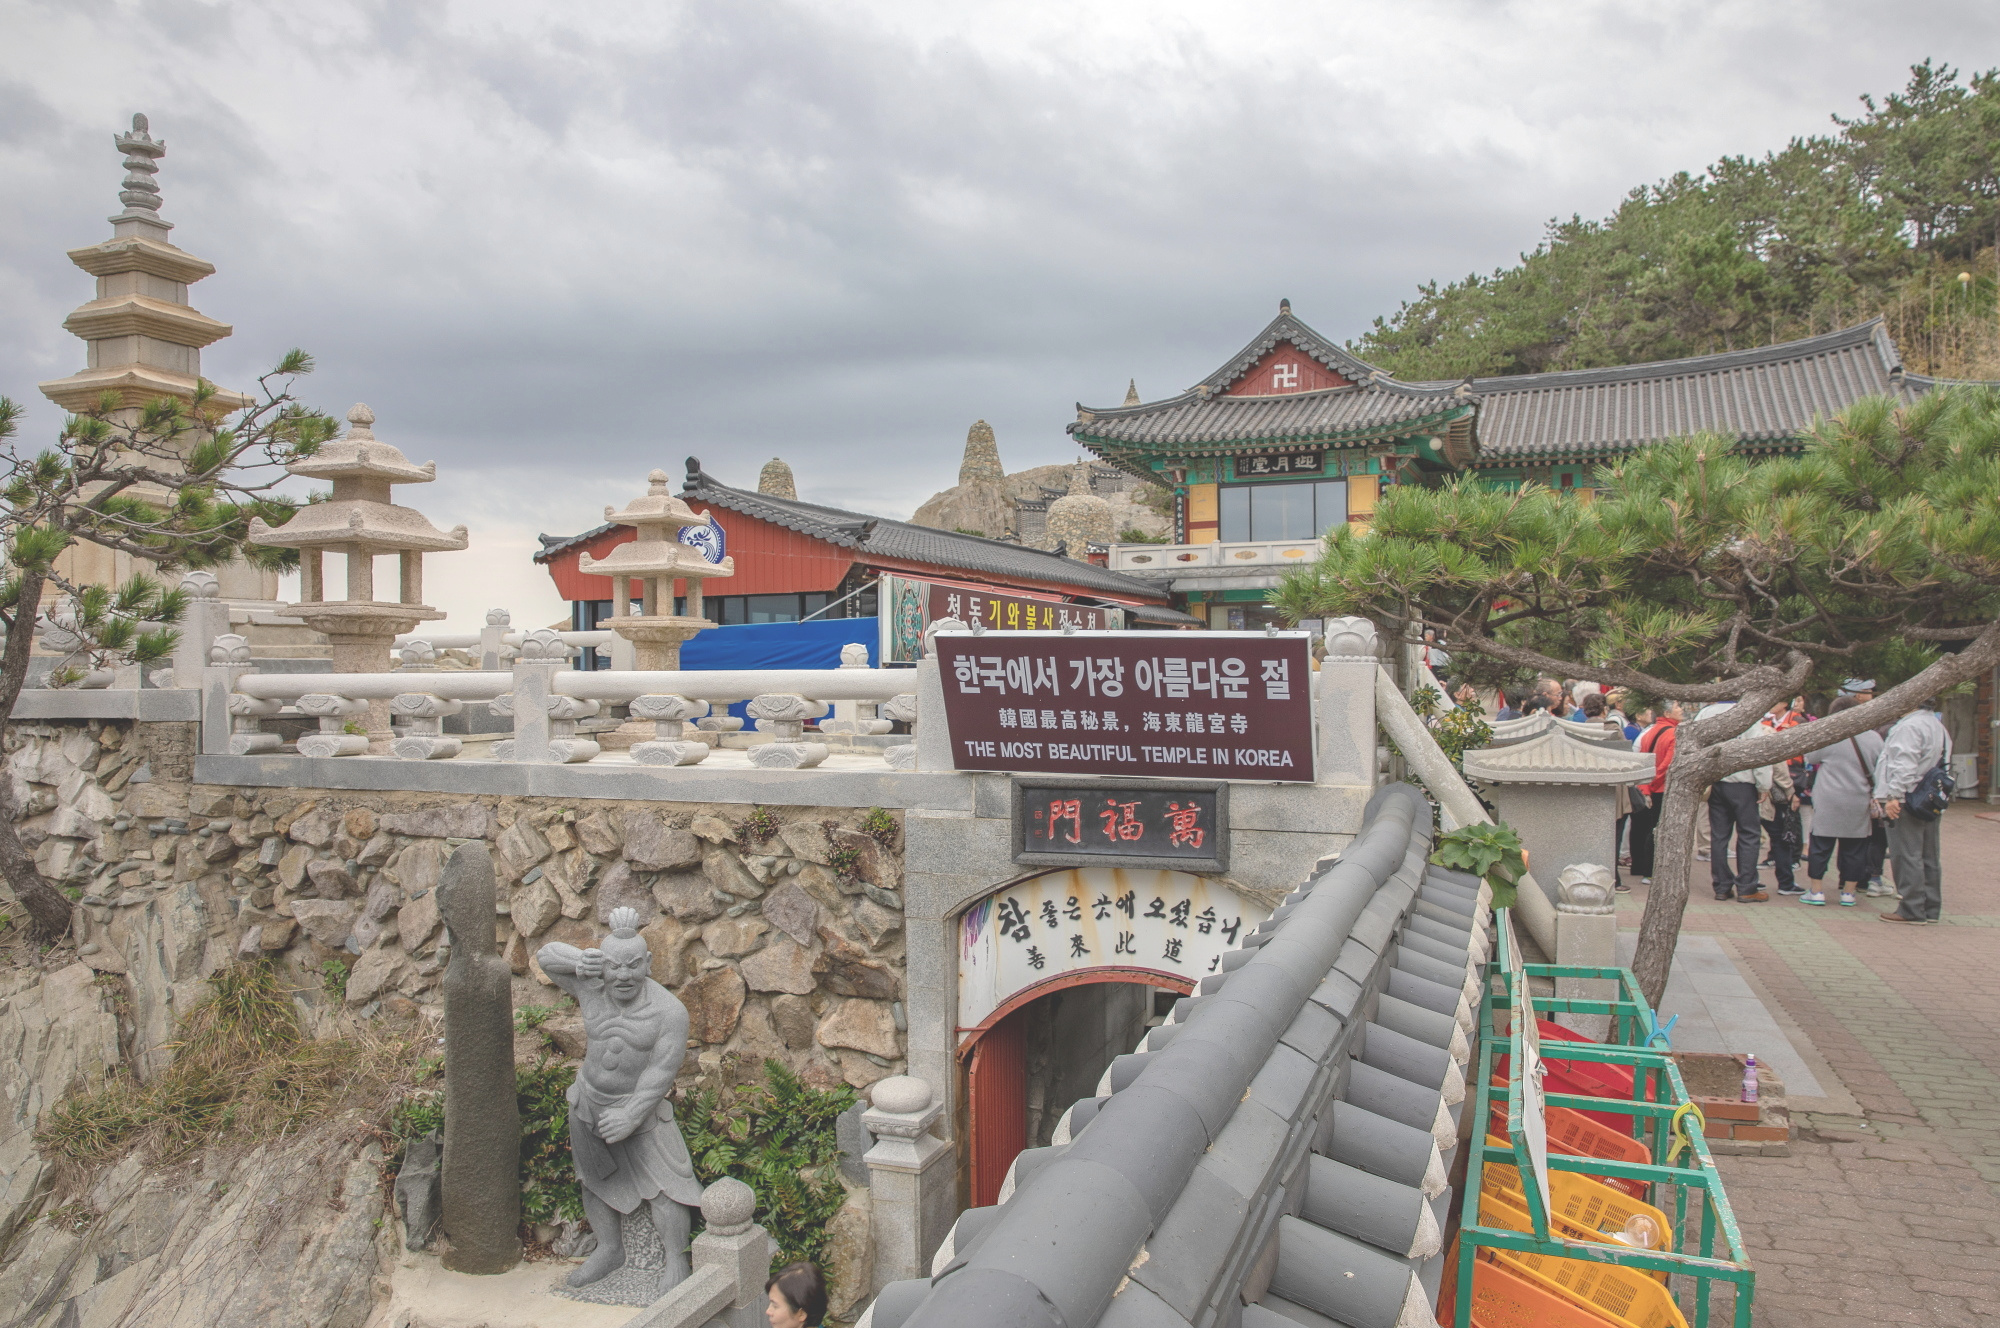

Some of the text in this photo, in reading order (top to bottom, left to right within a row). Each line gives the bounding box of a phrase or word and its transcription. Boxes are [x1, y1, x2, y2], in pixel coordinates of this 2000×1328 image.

[952, 654, 1291, 700] 한국에서 가장 아름다운 절
[964, 740, 1294, 767] THE MOST BEAUTIFUL TEMPLE IN KOREA
[997, 896, 1031, 943] 참
[1143, 896, 1256, 945] 오셨습니
